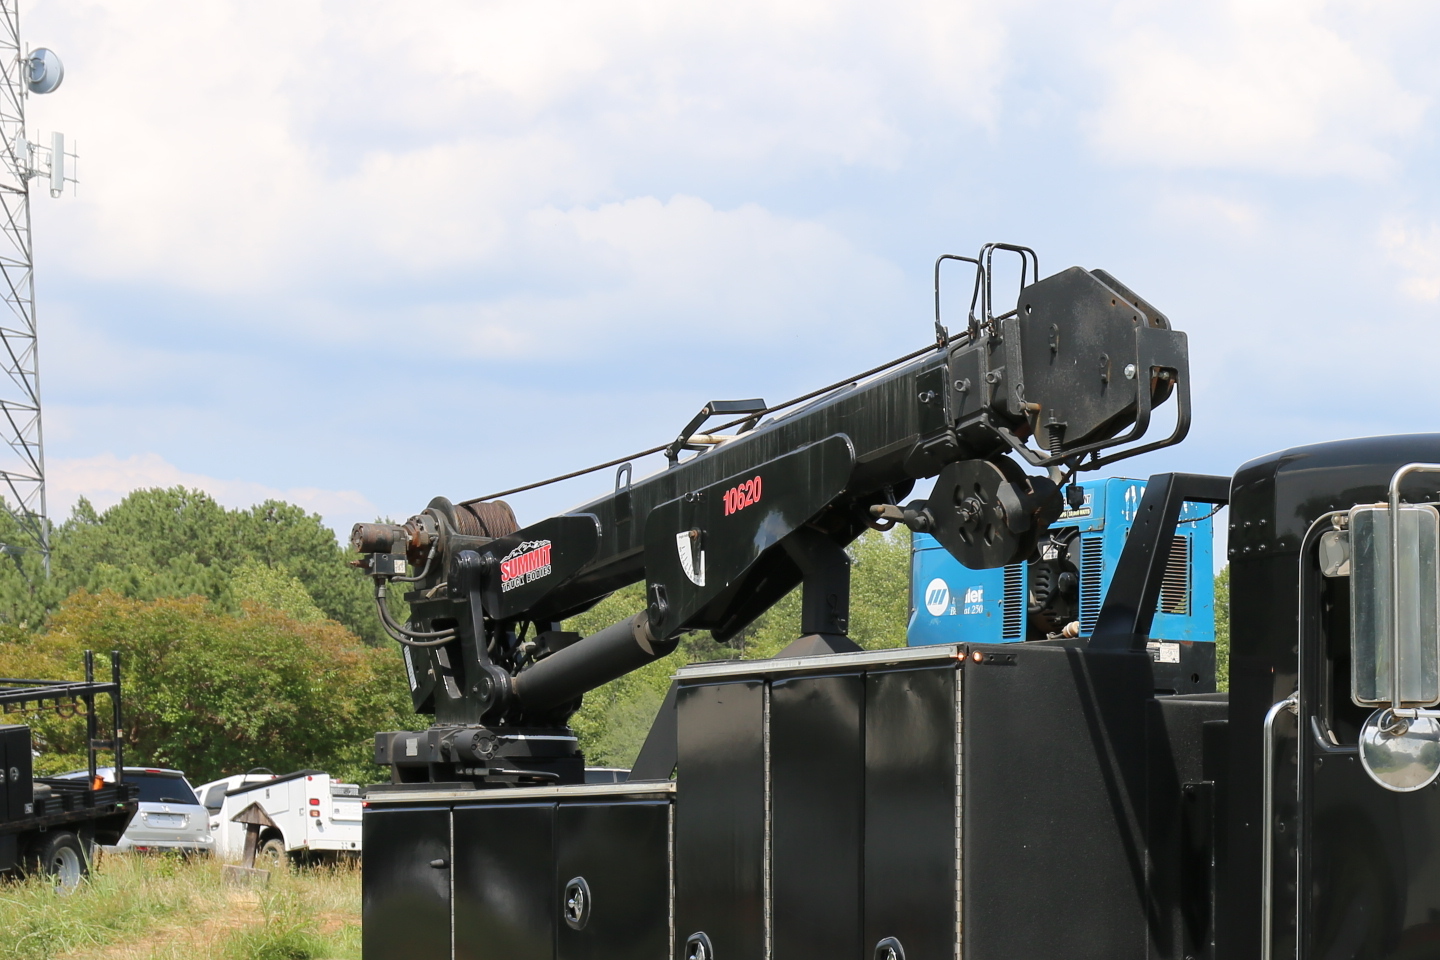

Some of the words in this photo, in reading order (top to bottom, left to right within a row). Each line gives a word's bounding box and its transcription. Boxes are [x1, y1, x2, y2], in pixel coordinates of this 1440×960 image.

[723, 475, 762, 516] 10620
[501, 544, 552, 582] SUMMIT
[502, 576, 525, 592] TRUCK
[525, 564, 551, 583] BODIES
